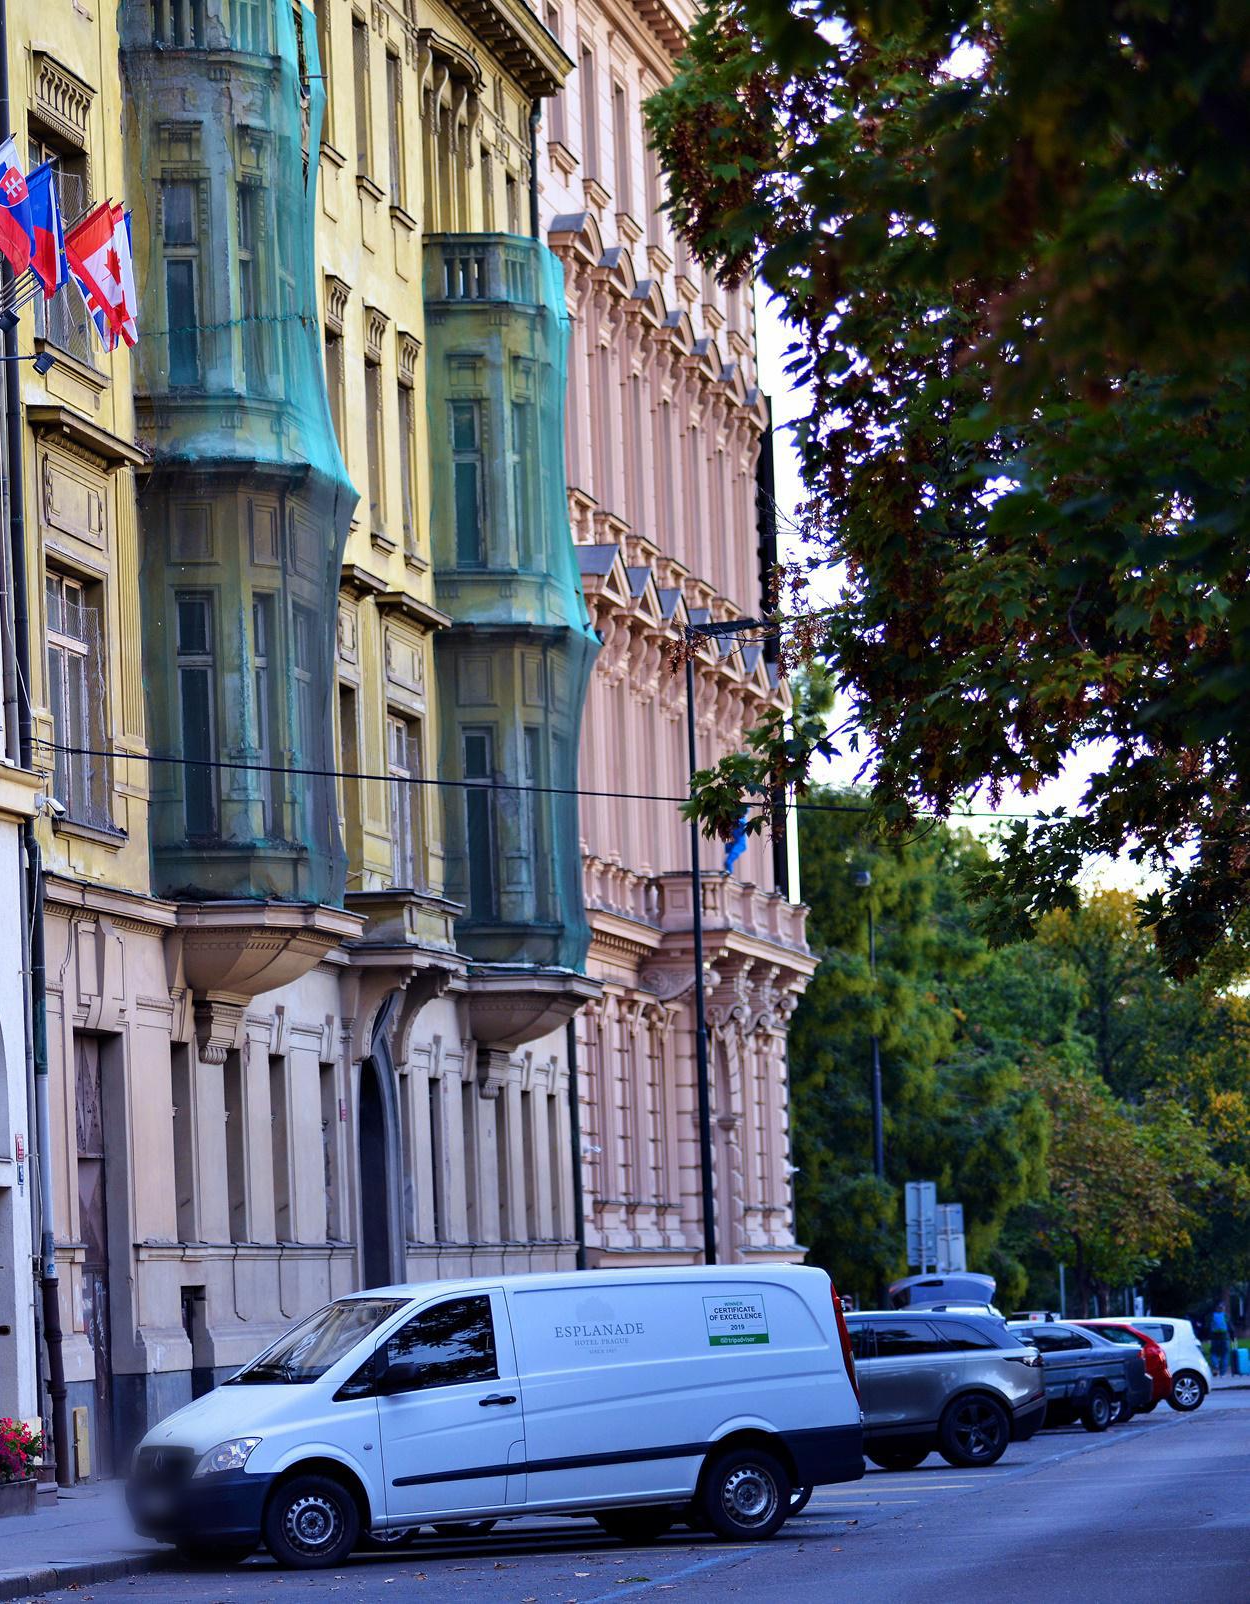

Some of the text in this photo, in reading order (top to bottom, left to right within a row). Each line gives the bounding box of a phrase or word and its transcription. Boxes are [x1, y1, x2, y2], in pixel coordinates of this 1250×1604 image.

[713, 1306, 756, 1314] CERTIFICATE
[720, 1312, 763, 1320] EXCELLENCE
[554, 1322, 645, 1338] ESPLANADE
[601, 1337, 629, 1345] PRAGUE
